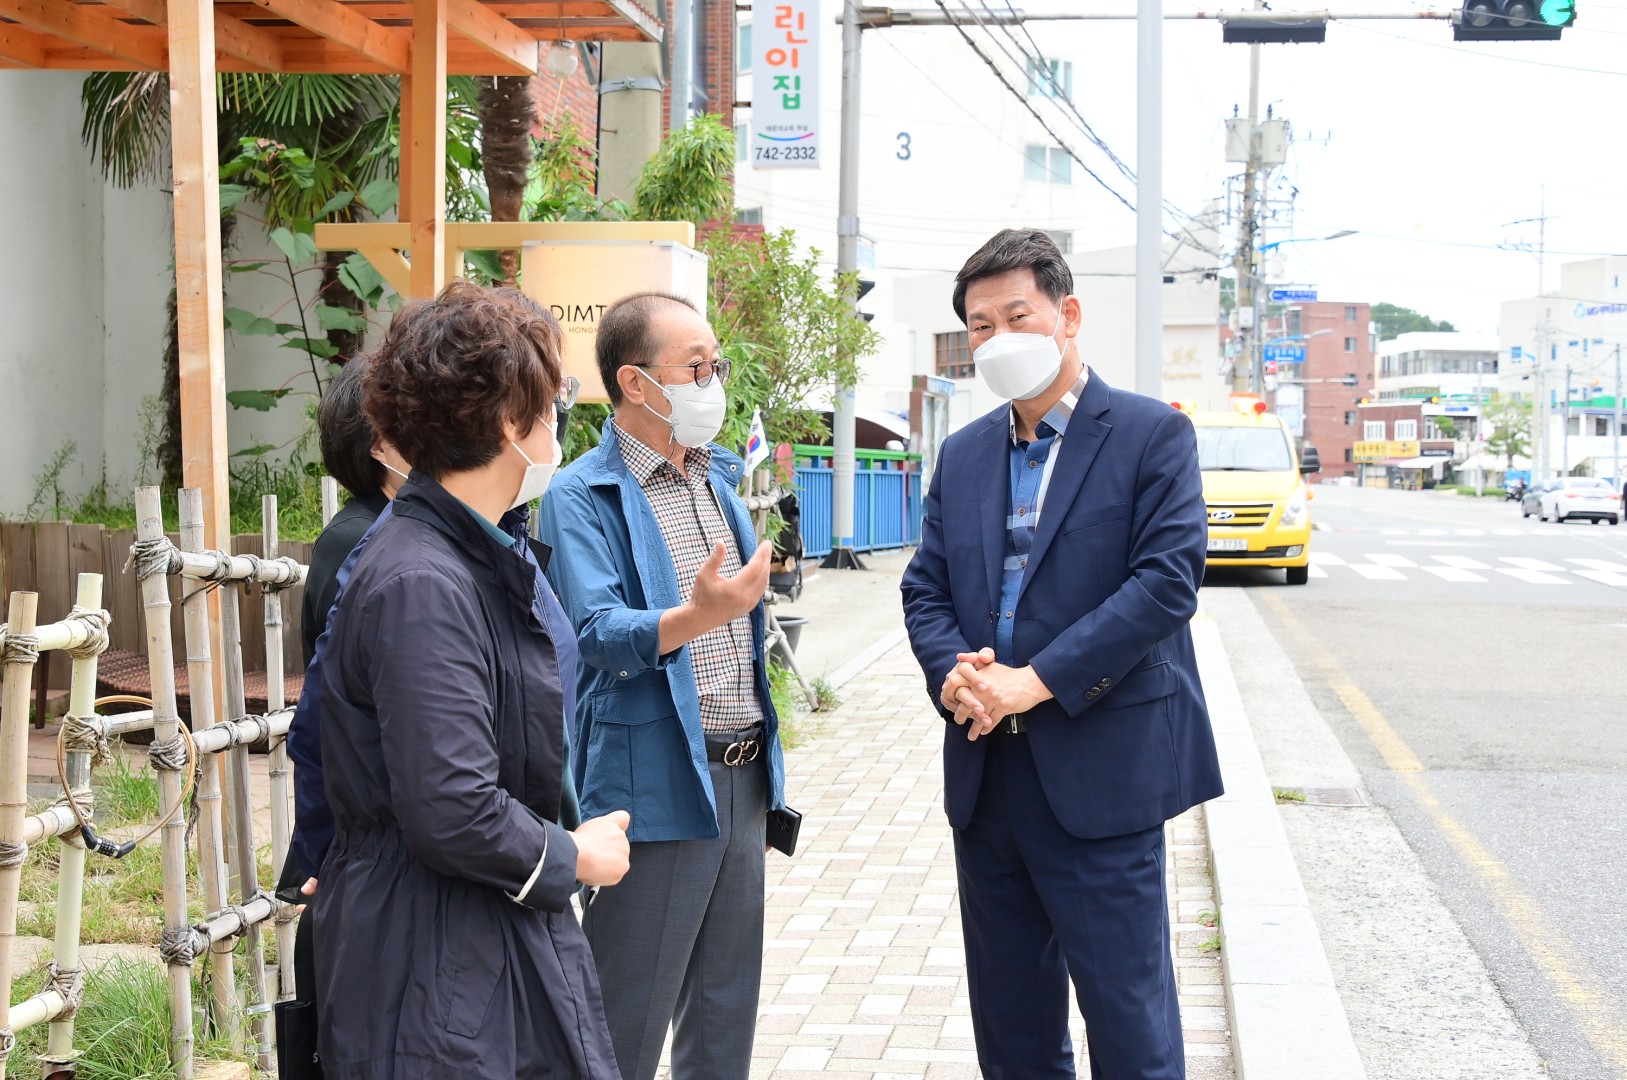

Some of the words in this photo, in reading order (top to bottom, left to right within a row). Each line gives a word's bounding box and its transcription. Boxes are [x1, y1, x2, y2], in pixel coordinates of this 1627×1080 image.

[765, 5, 808, 110] 린이집
[755, 146, 816, 160] 742-2332
[896, 131, 911, 161] 3
